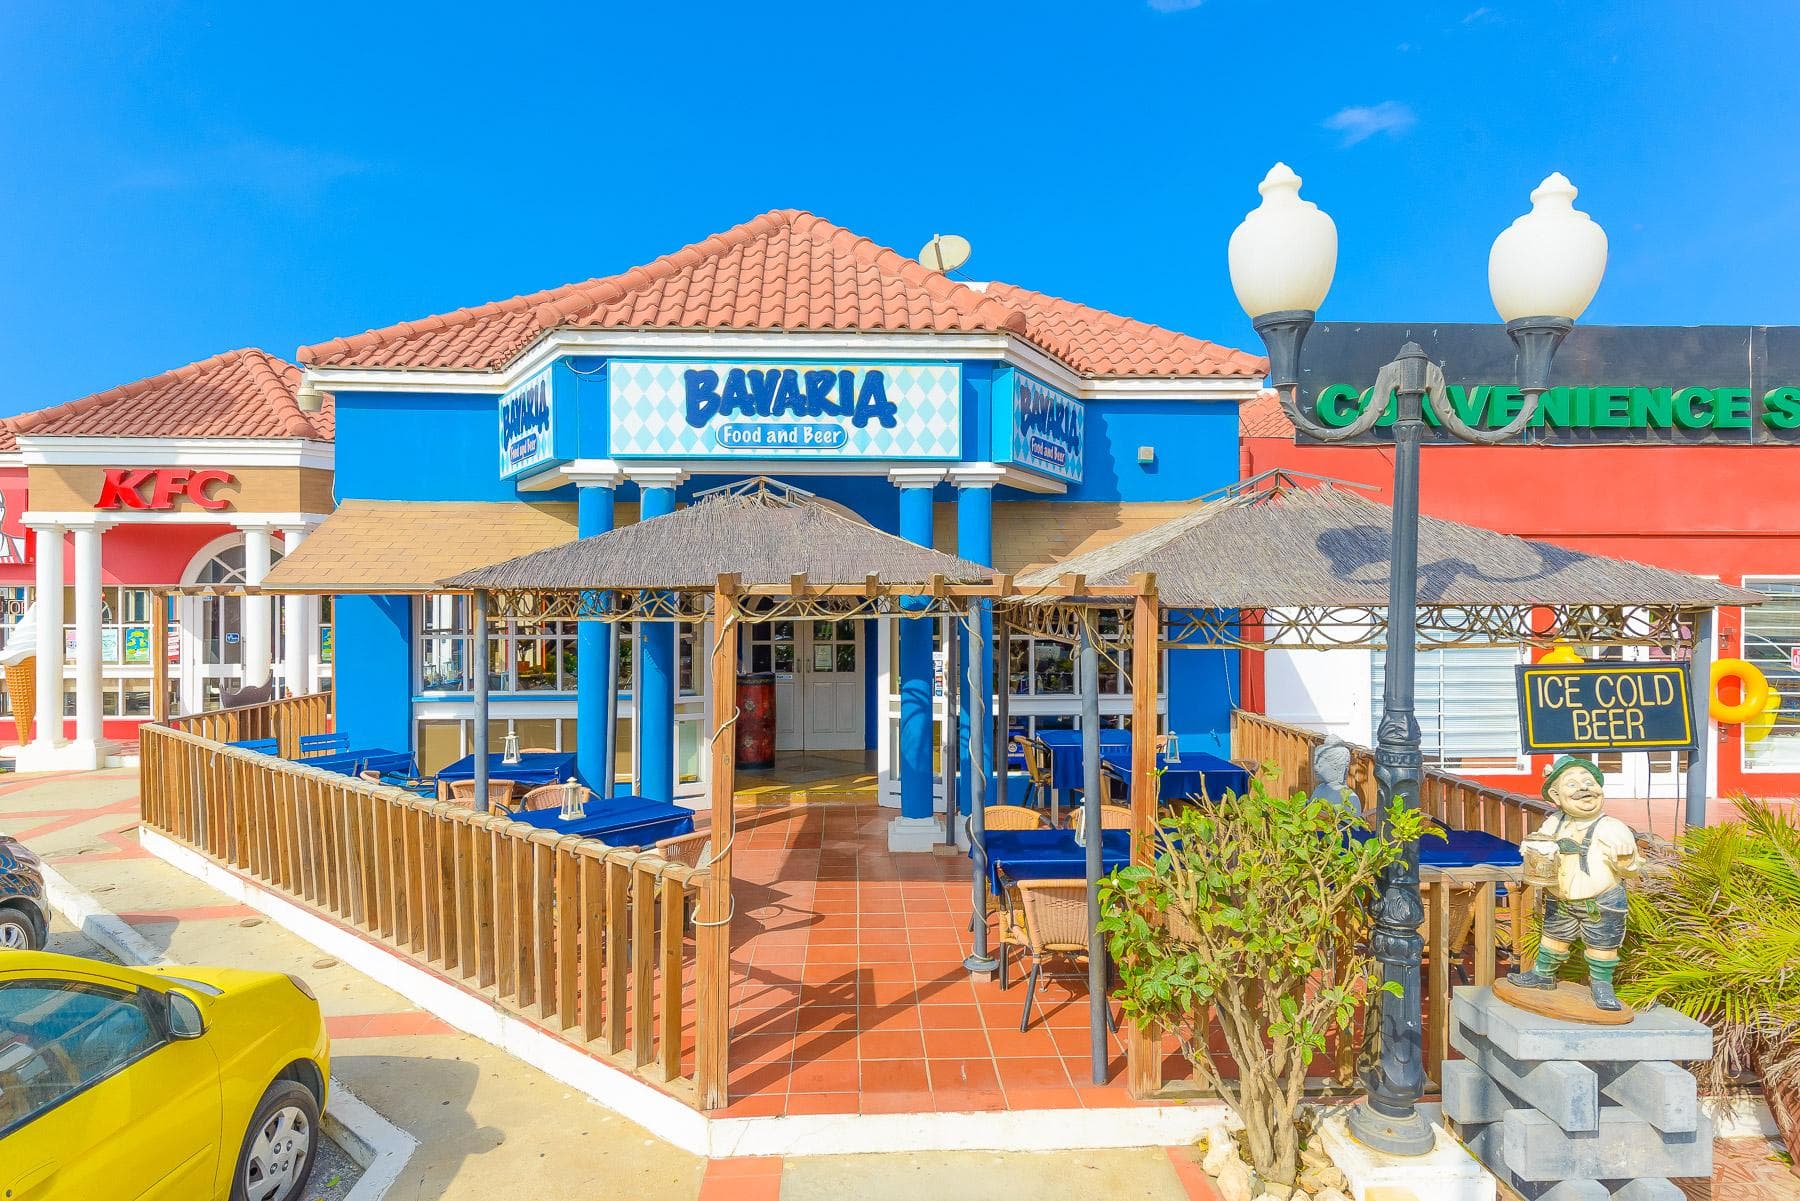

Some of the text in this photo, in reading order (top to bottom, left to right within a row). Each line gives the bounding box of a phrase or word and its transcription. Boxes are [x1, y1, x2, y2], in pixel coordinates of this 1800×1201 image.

[503, 380, 549, 452] BAVARIA
[684, 368, 897, 428] BAVARIA
[723, 426, 842, 443] Food and Beer
[1020, 385, 1079, 456] BAVARIA
[94, 469, 234, 509] KFC
[1537, 675, 1674, 708] ICE COLD
[1572, 708, 1645, 740] BEER
